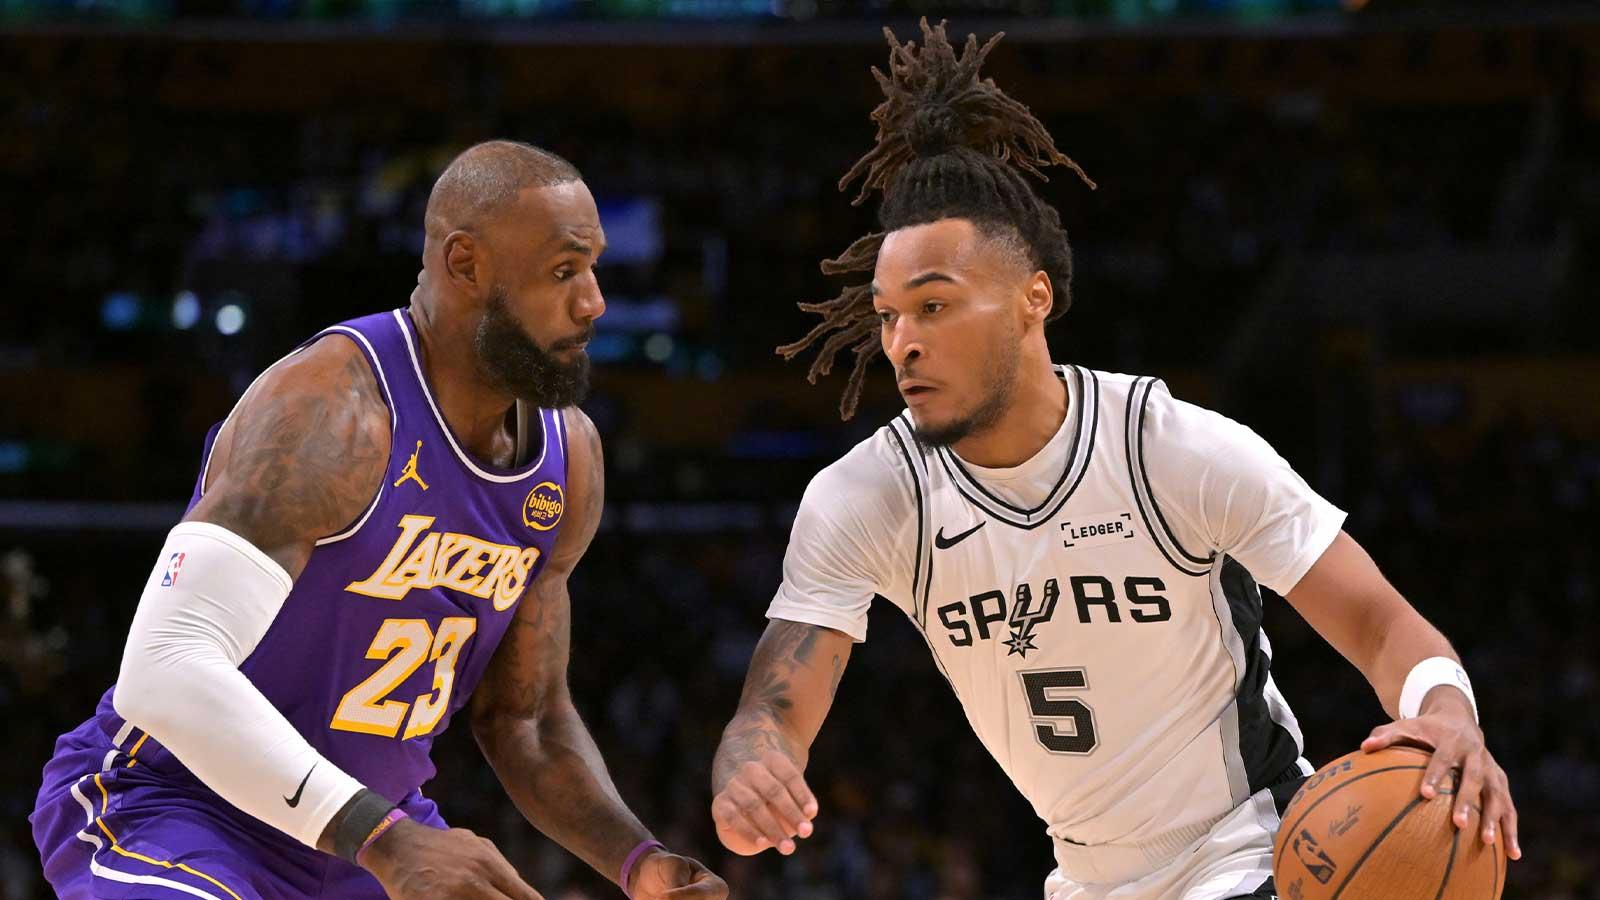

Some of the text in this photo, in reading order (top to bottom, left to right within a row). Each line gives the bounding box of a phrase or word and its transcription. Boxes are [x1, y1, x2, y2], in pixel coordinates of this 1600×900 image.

[528, 493, 561, 518] bibigo
[1071, 522, 1124, 539] LEDGER
[344, 514, 541, 611] LAKERS
[937, 575, 1172, 660] SPURS
[329, 617, 477, 741] 23
[1016, 666, 1101, 757] 5
